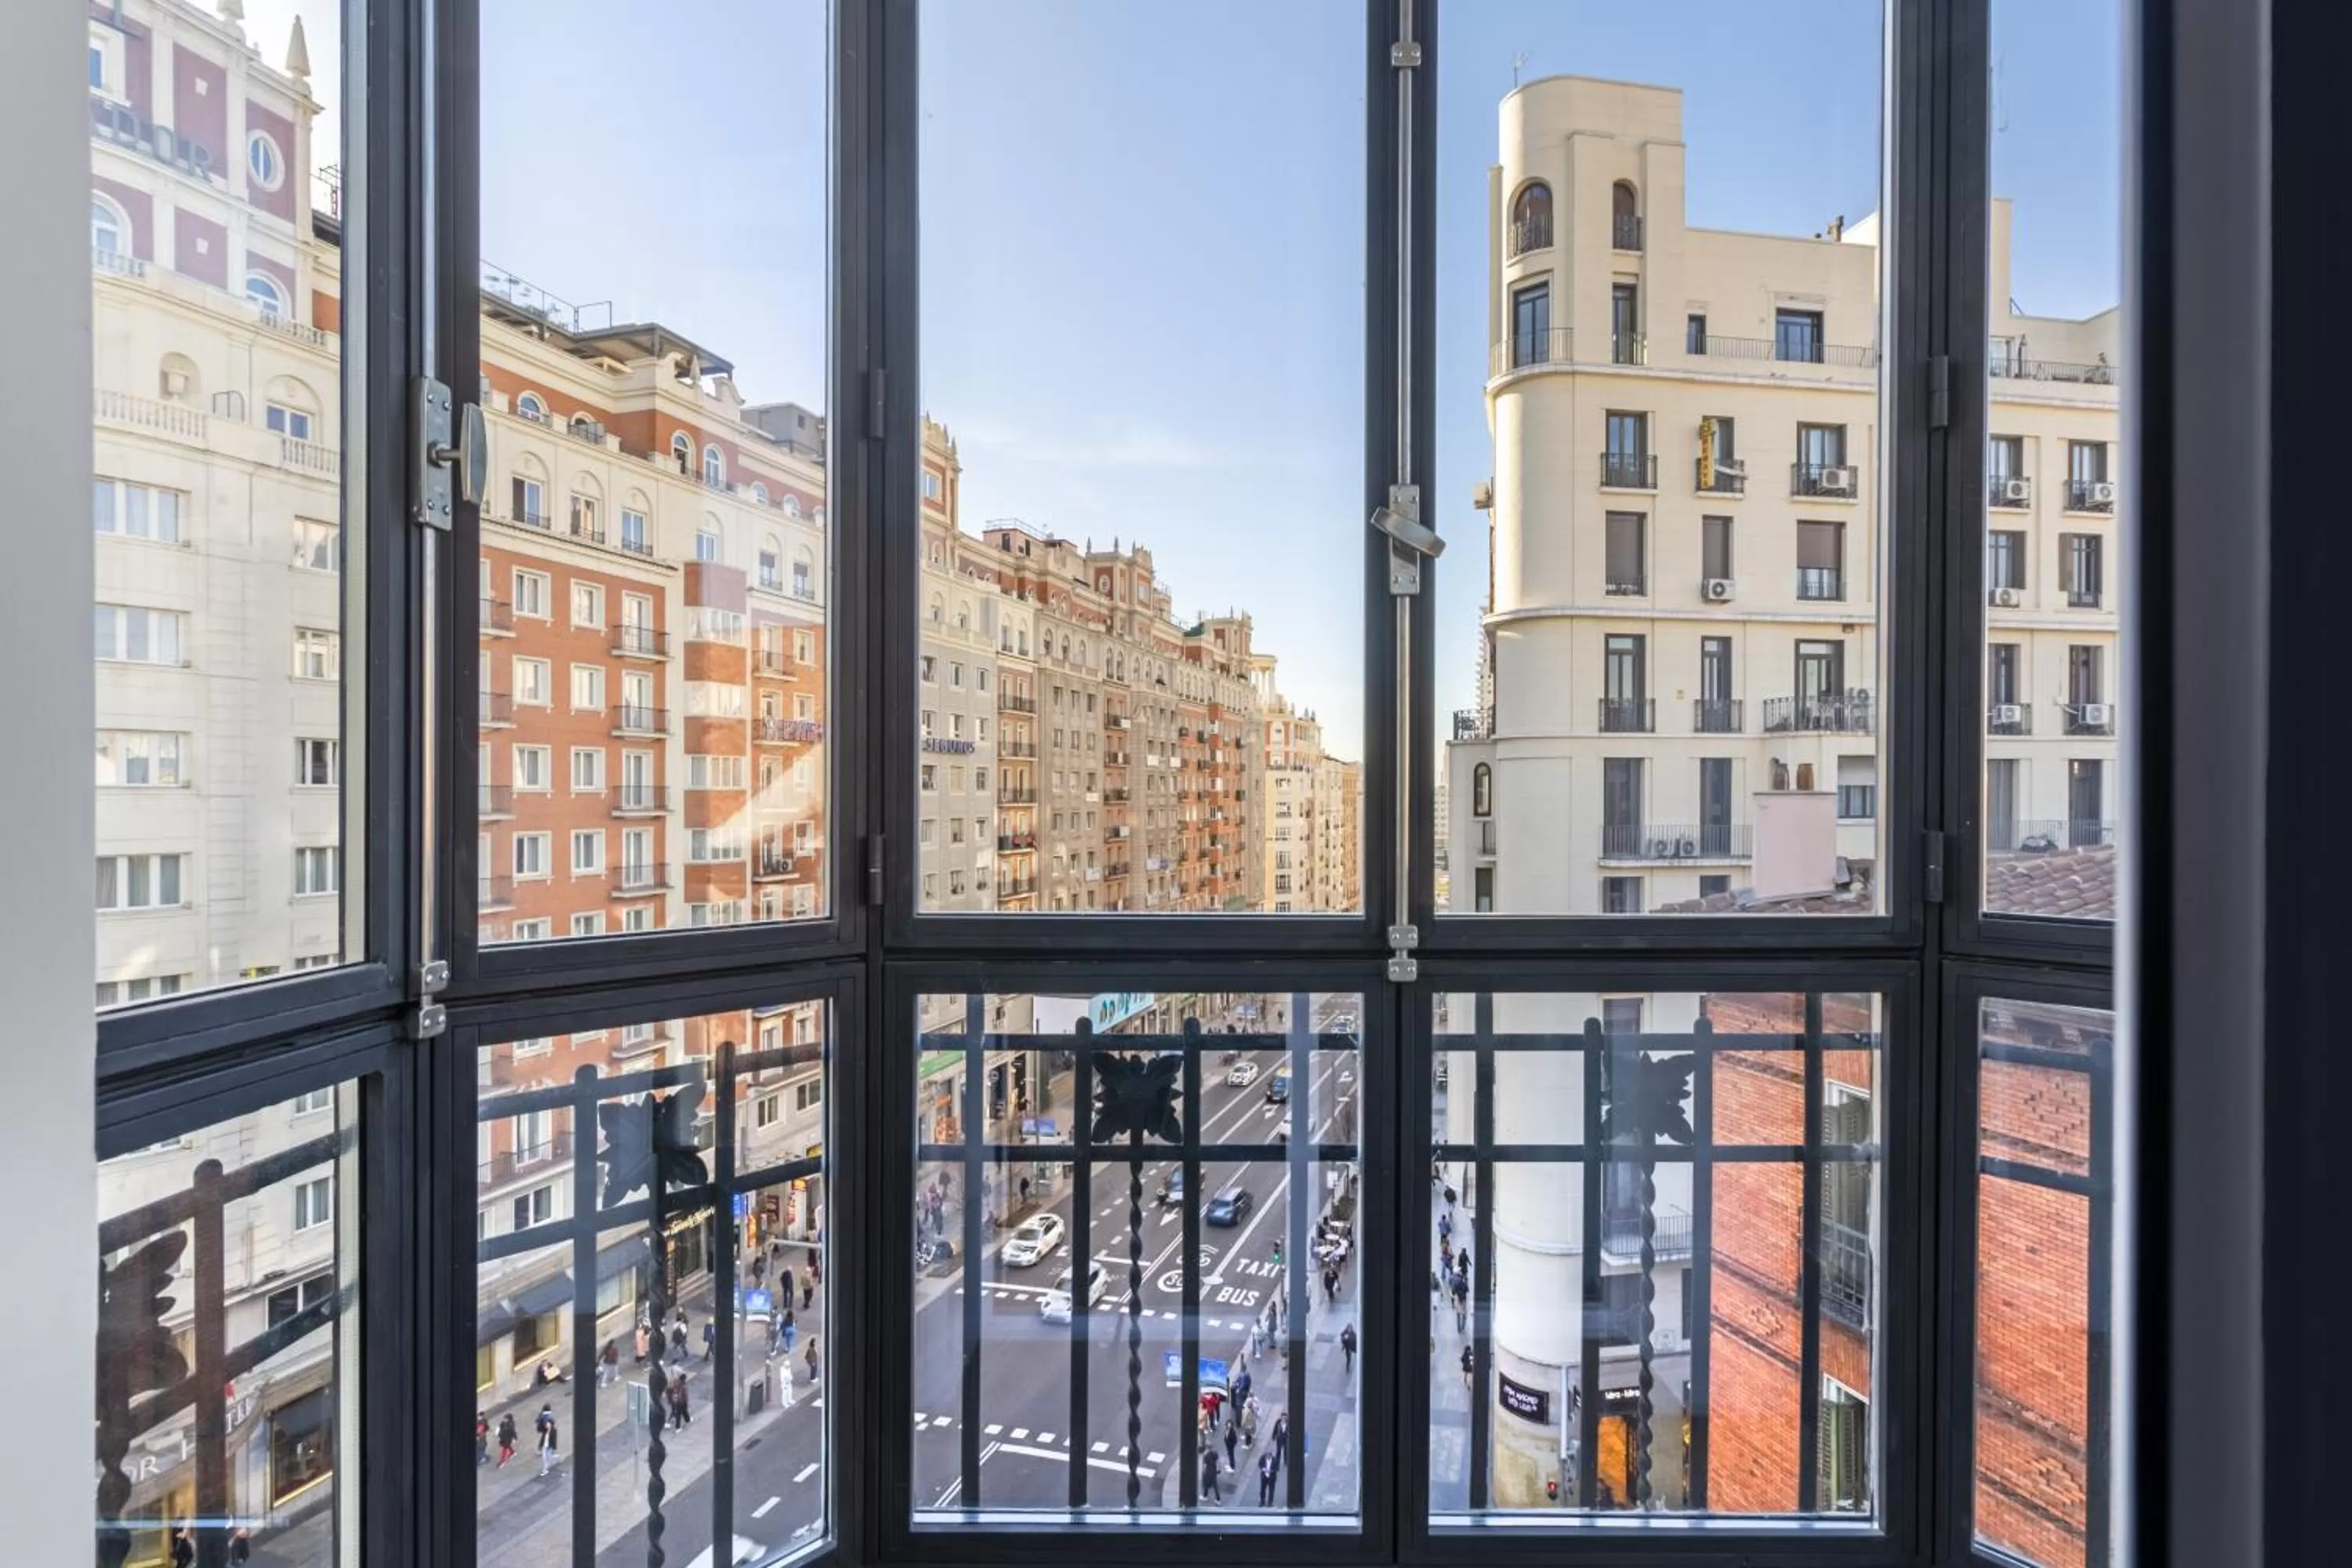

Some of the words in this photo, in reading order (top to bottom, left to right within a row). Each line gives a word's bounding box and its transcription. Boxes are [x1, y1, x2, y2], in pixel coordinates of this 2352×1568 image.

[91, 106, 213, 182] DOR
[1236, 1258, 1280, 1278] TAXI
[1217, 1287, 1260, 1307] BUS
